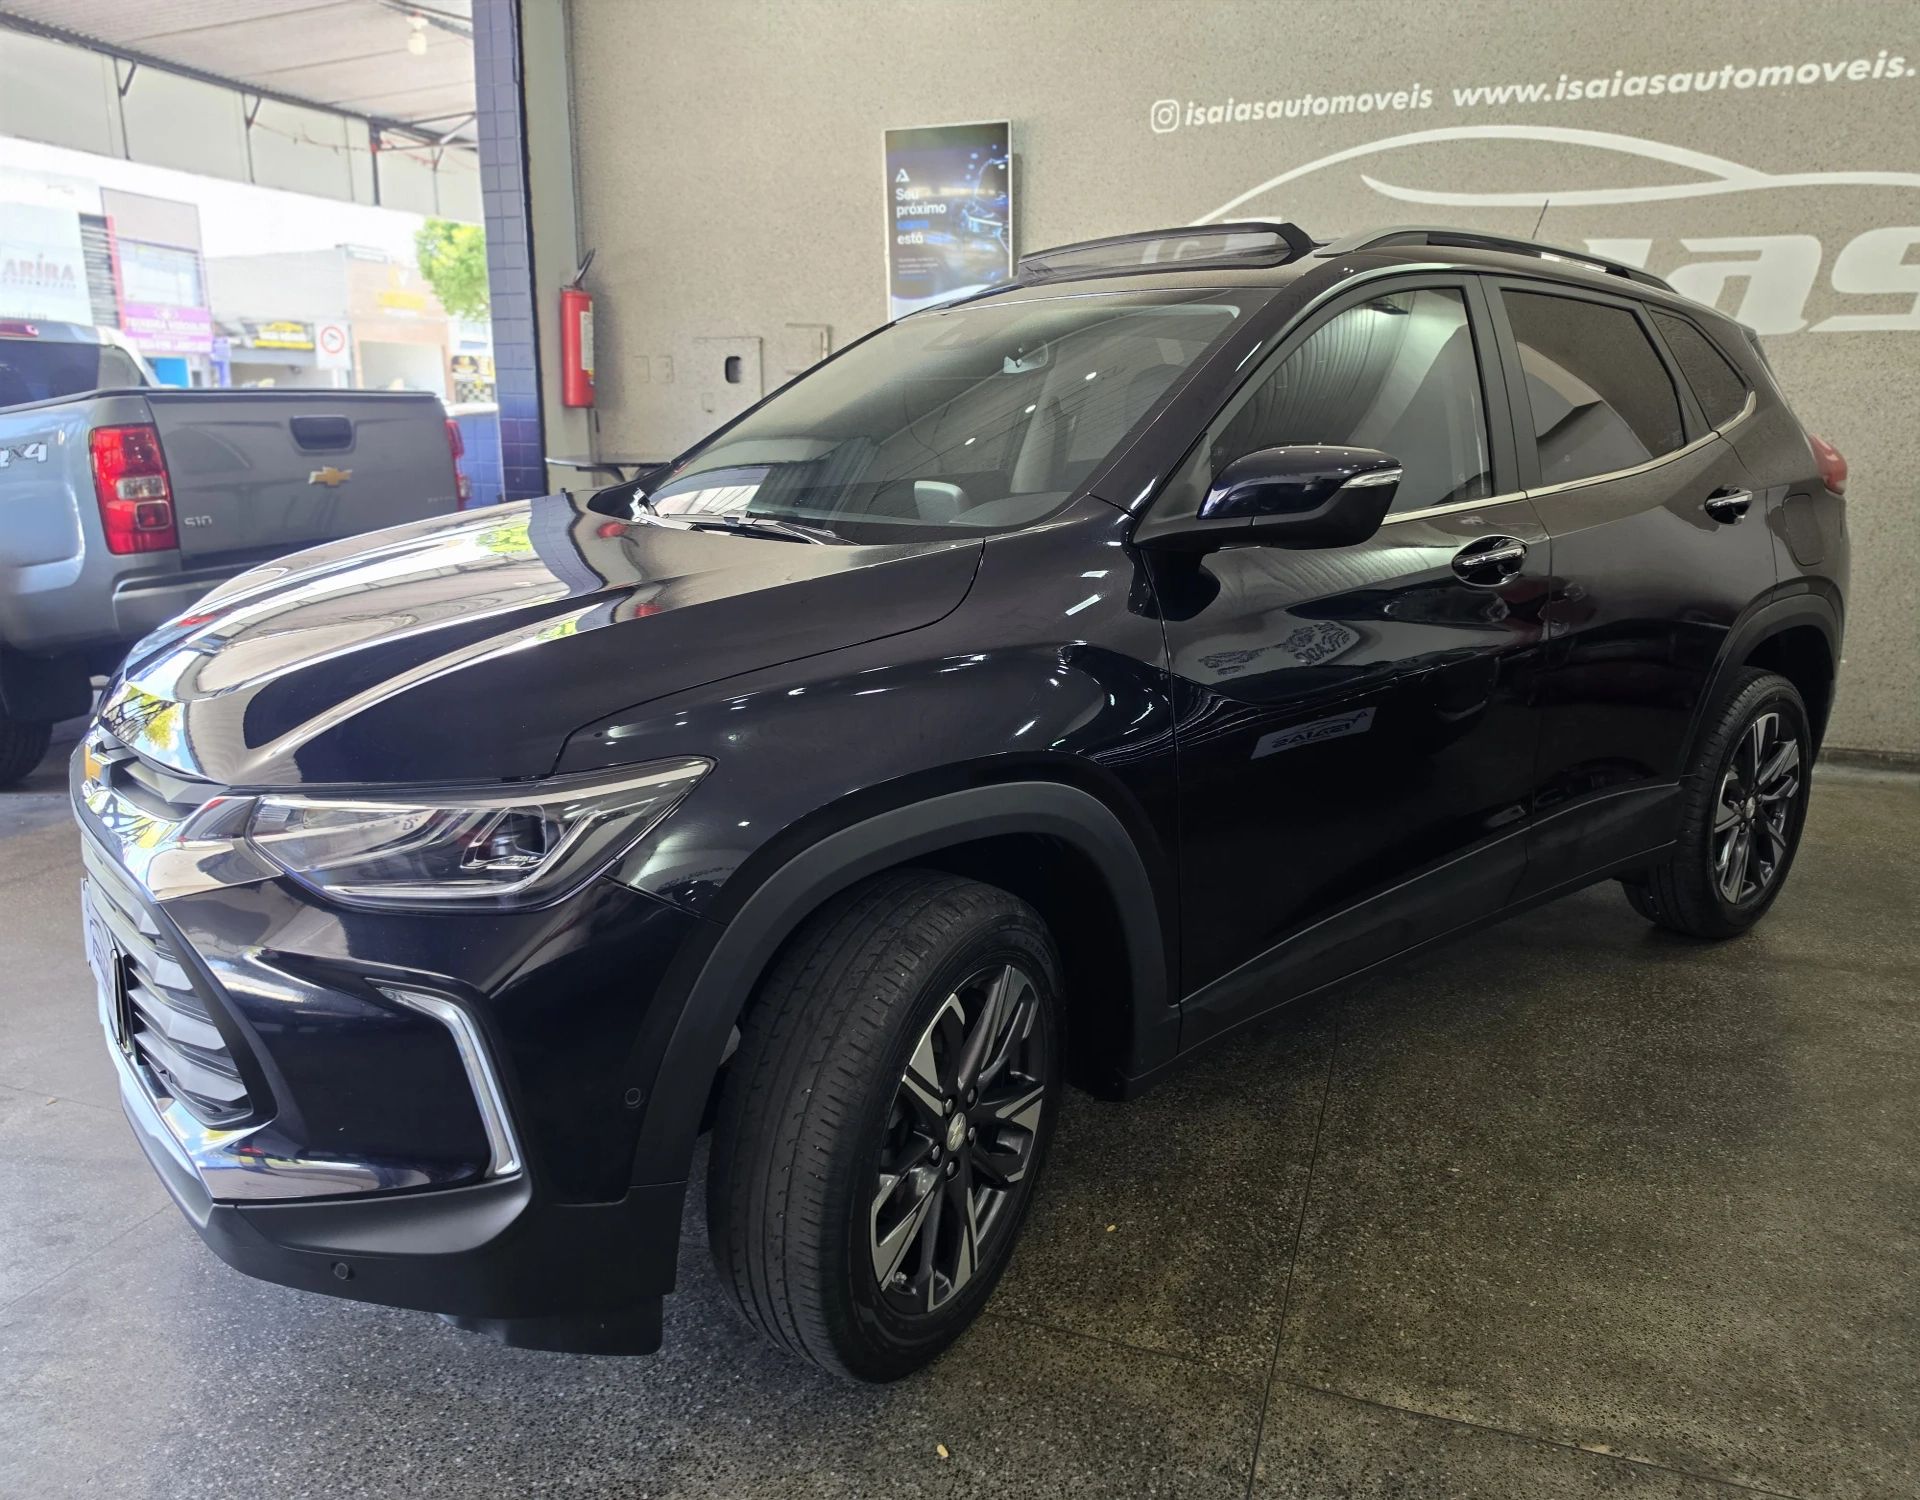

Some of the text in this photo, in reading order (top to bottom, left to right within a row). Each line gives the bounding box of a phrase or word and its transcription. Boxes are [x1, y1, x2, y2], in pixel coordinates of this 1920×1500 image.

[1185, 50, 1917, 126] isaiasautomoveis www.isaiasautomoveis.
[895, 188, 919, 201] Seu
[896, 202, 947, 219] próximo
[897, 231, 924, 245] está
[184, 514, 212, 528] S10
